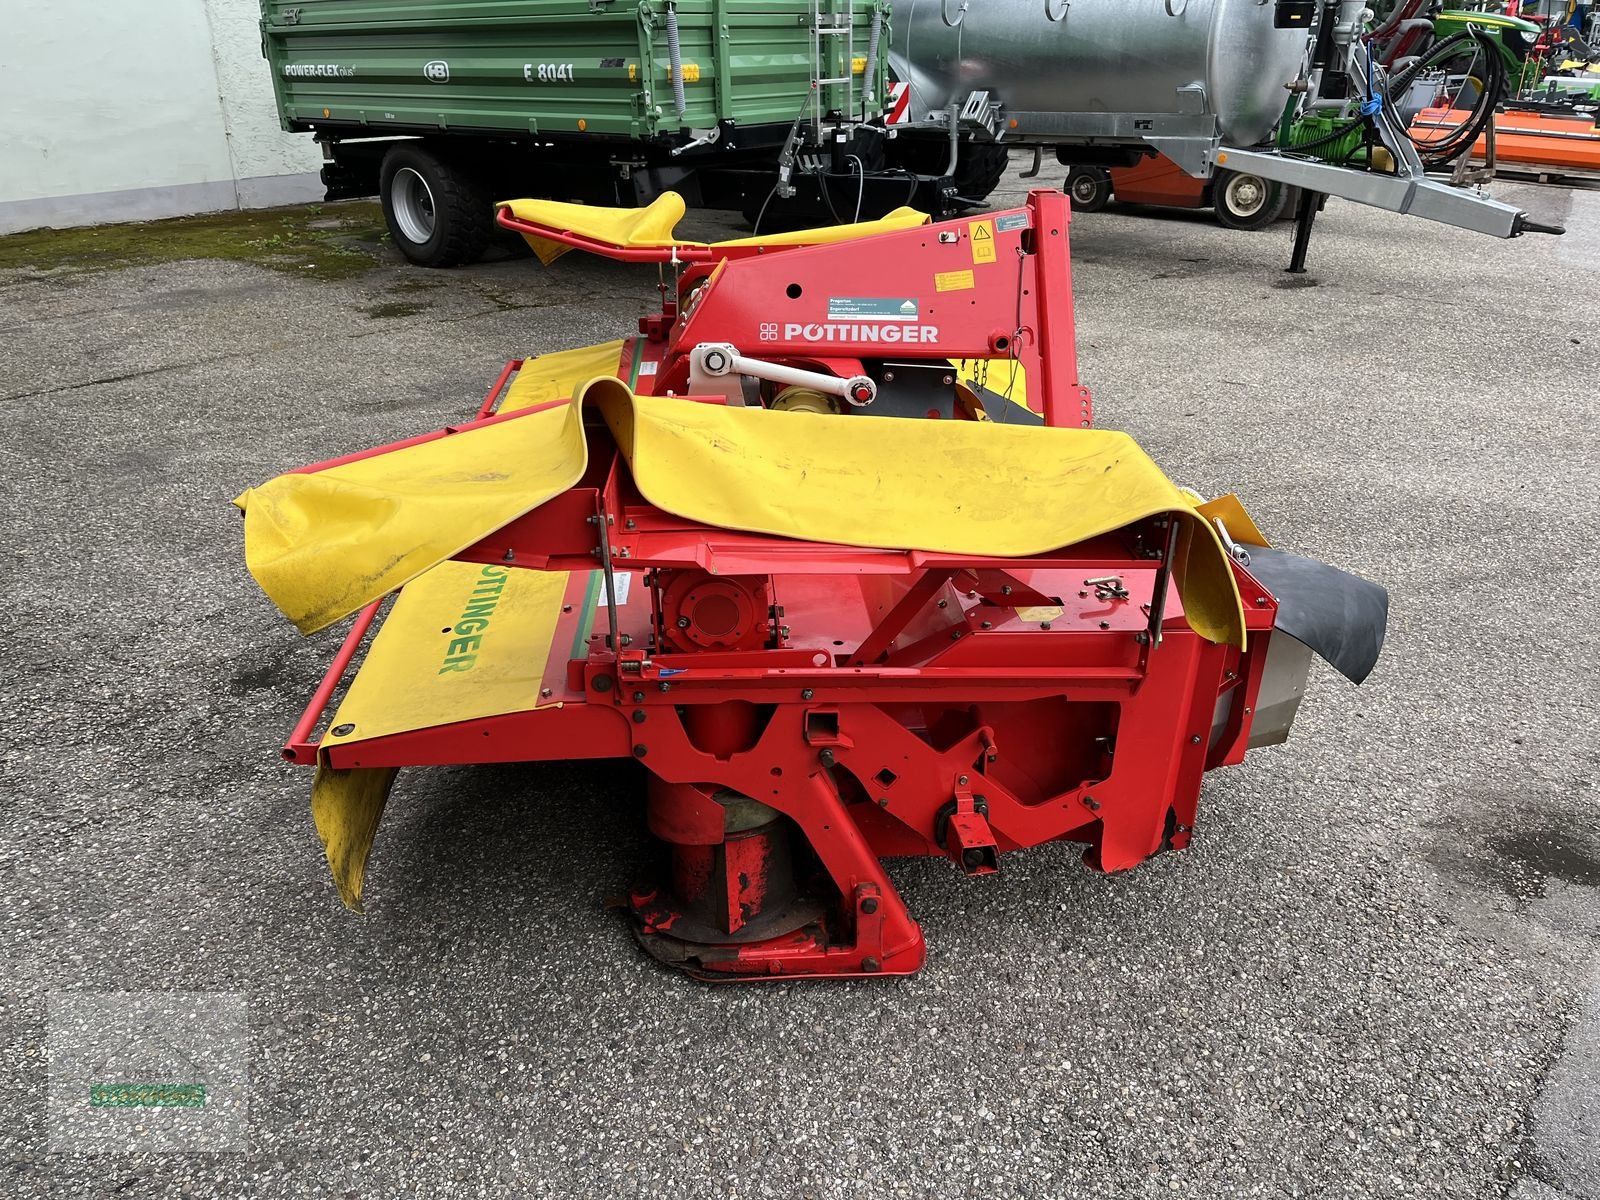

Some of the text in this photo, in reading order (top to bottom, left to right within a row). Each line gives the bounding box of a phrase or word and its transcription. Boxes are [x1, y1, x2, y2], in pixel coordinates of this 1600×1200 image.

[523, 63, 575, 82] E 8041
[784, 323, 938, 343] PÖTTINGER
[439, 564, 511, 675] ÖTTINGER
